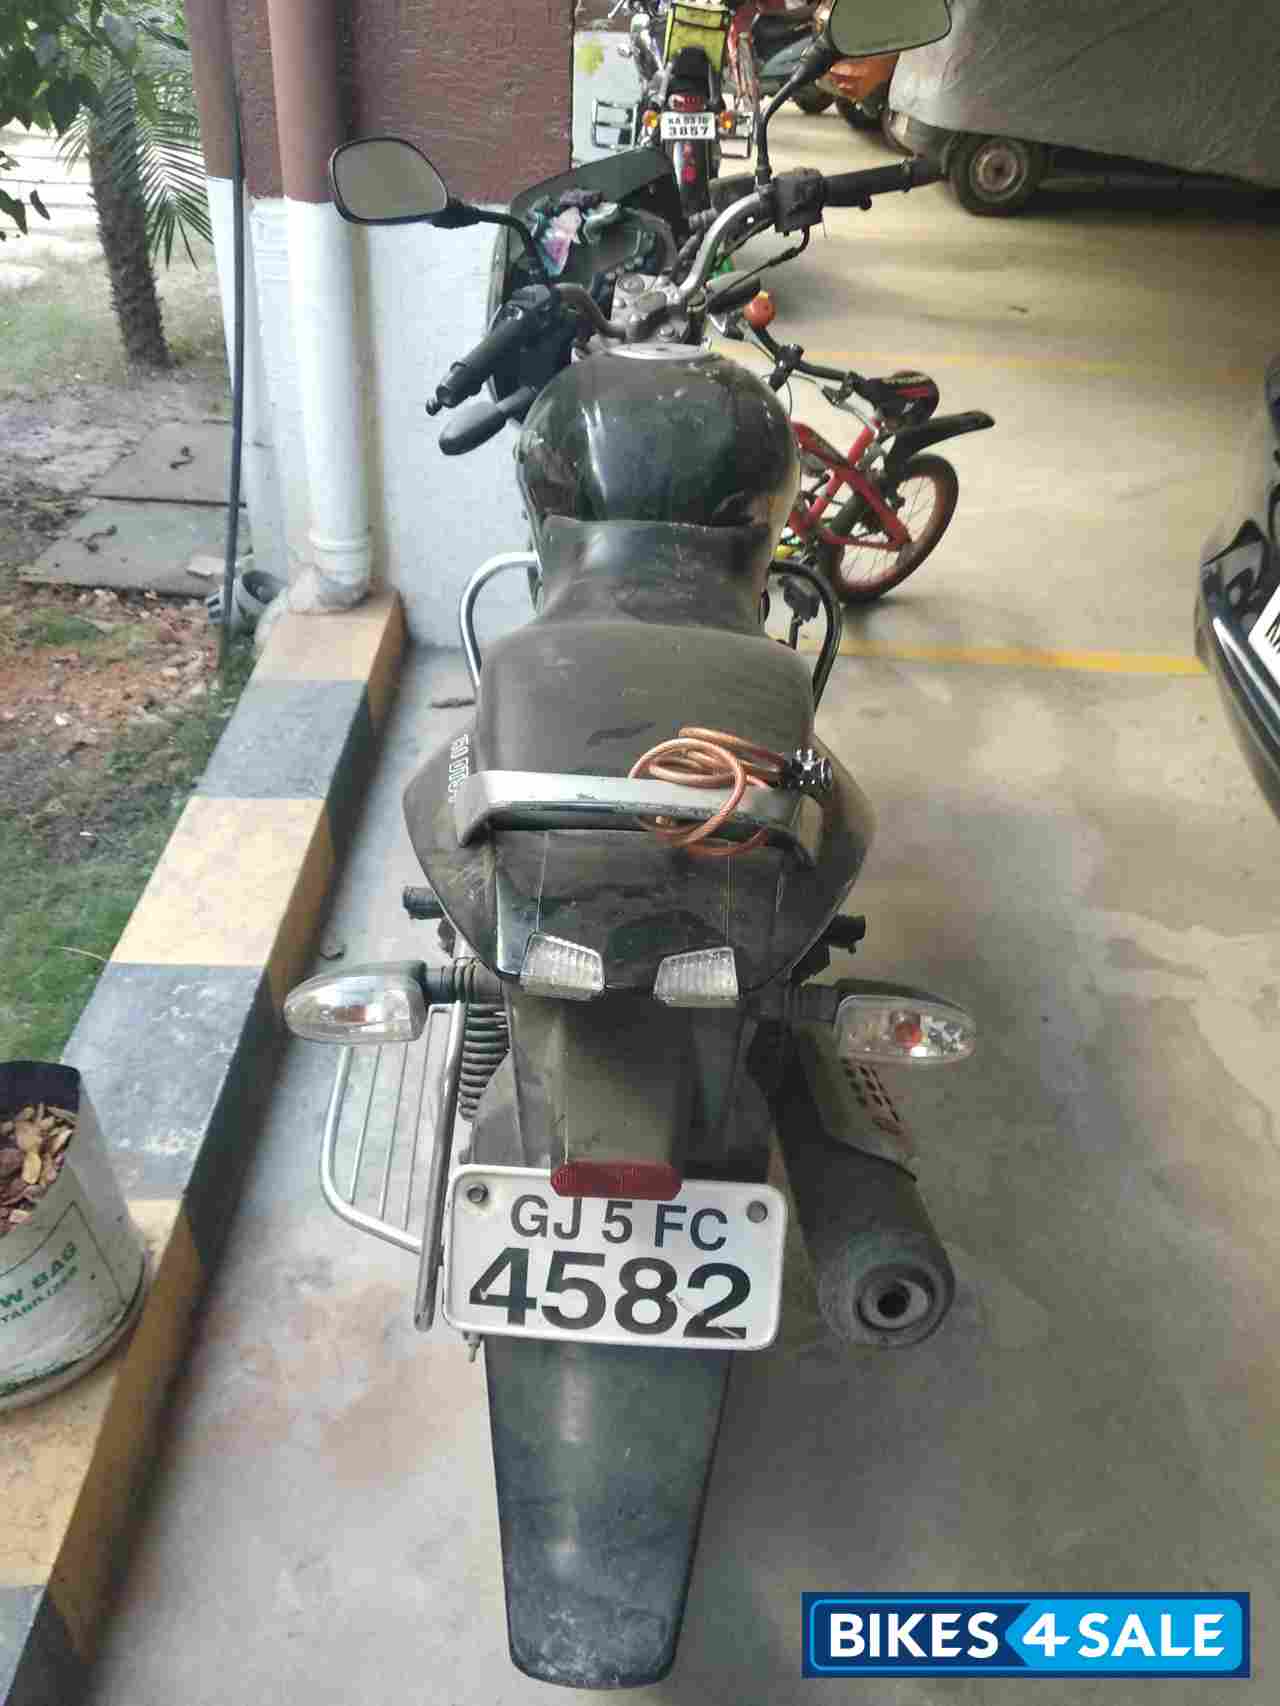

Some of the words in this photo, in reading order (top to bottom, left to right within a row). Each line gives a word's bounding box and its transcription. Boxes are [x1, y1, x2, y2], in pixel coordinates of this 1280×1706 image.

[510, 1194, 583, 1240] GJ
[601, 1200, 633, 1244] 5
[654, 1203, 728, 1251] FC
[469, 1247, 751, 1340] 4582
